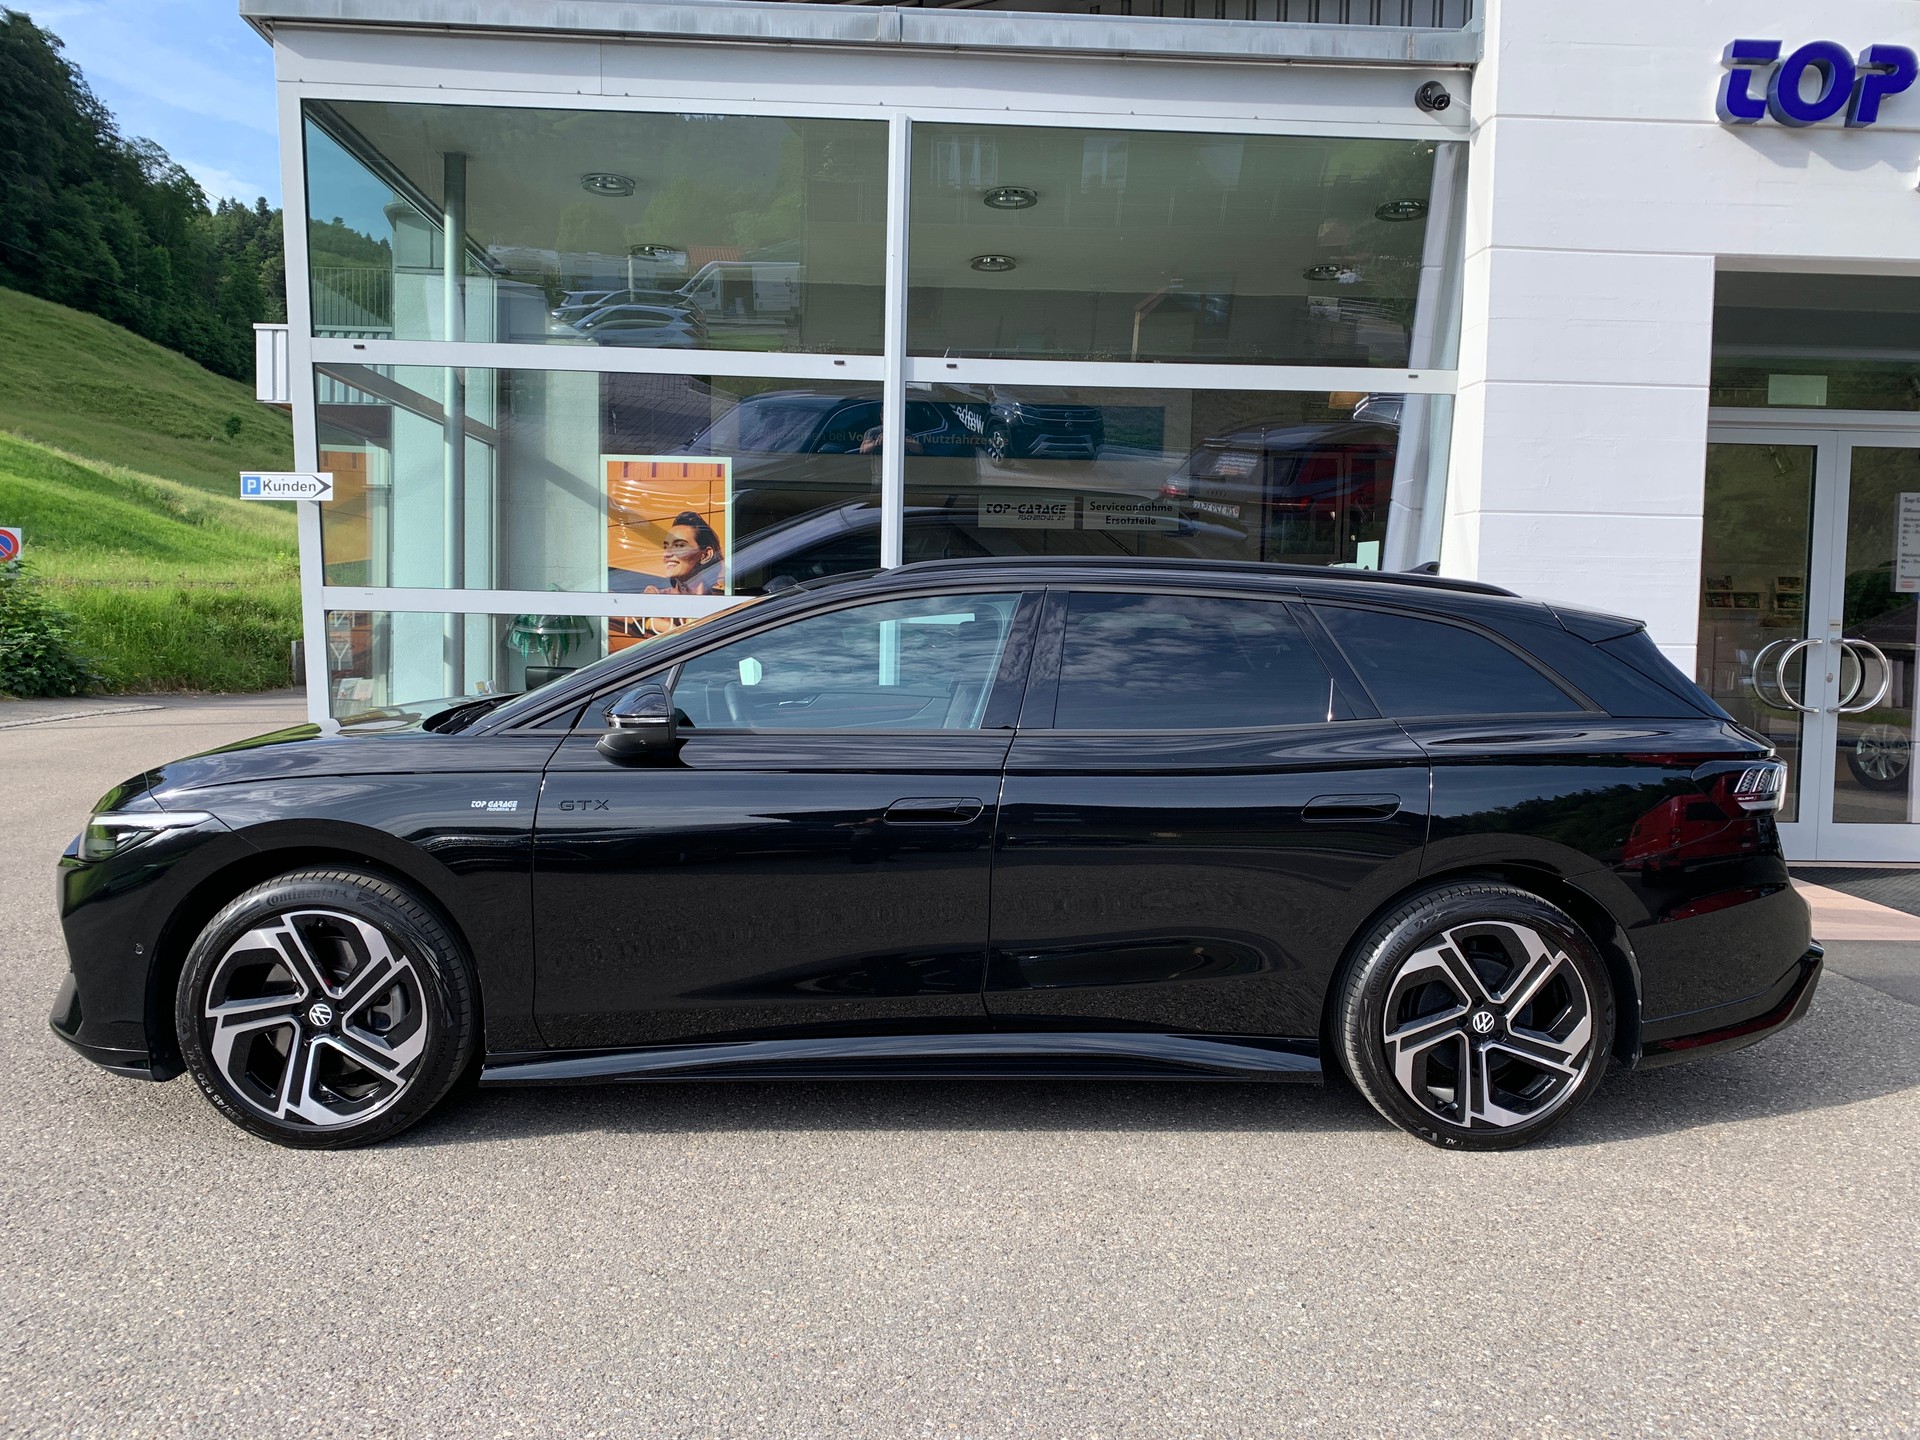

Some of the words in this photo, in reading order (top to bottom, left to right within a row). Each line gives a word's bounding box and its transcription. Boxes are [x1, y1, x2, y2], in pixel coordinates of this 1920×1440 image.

[263, 480, 317, 492] Kunden
[1090, 501, 1173, 512] Serviceannahme
[1105, 515, 1157, 525] Ersatzteile
[558, 799, 609, 811] GTX
[1368, 936, 1407, 997] Continental
